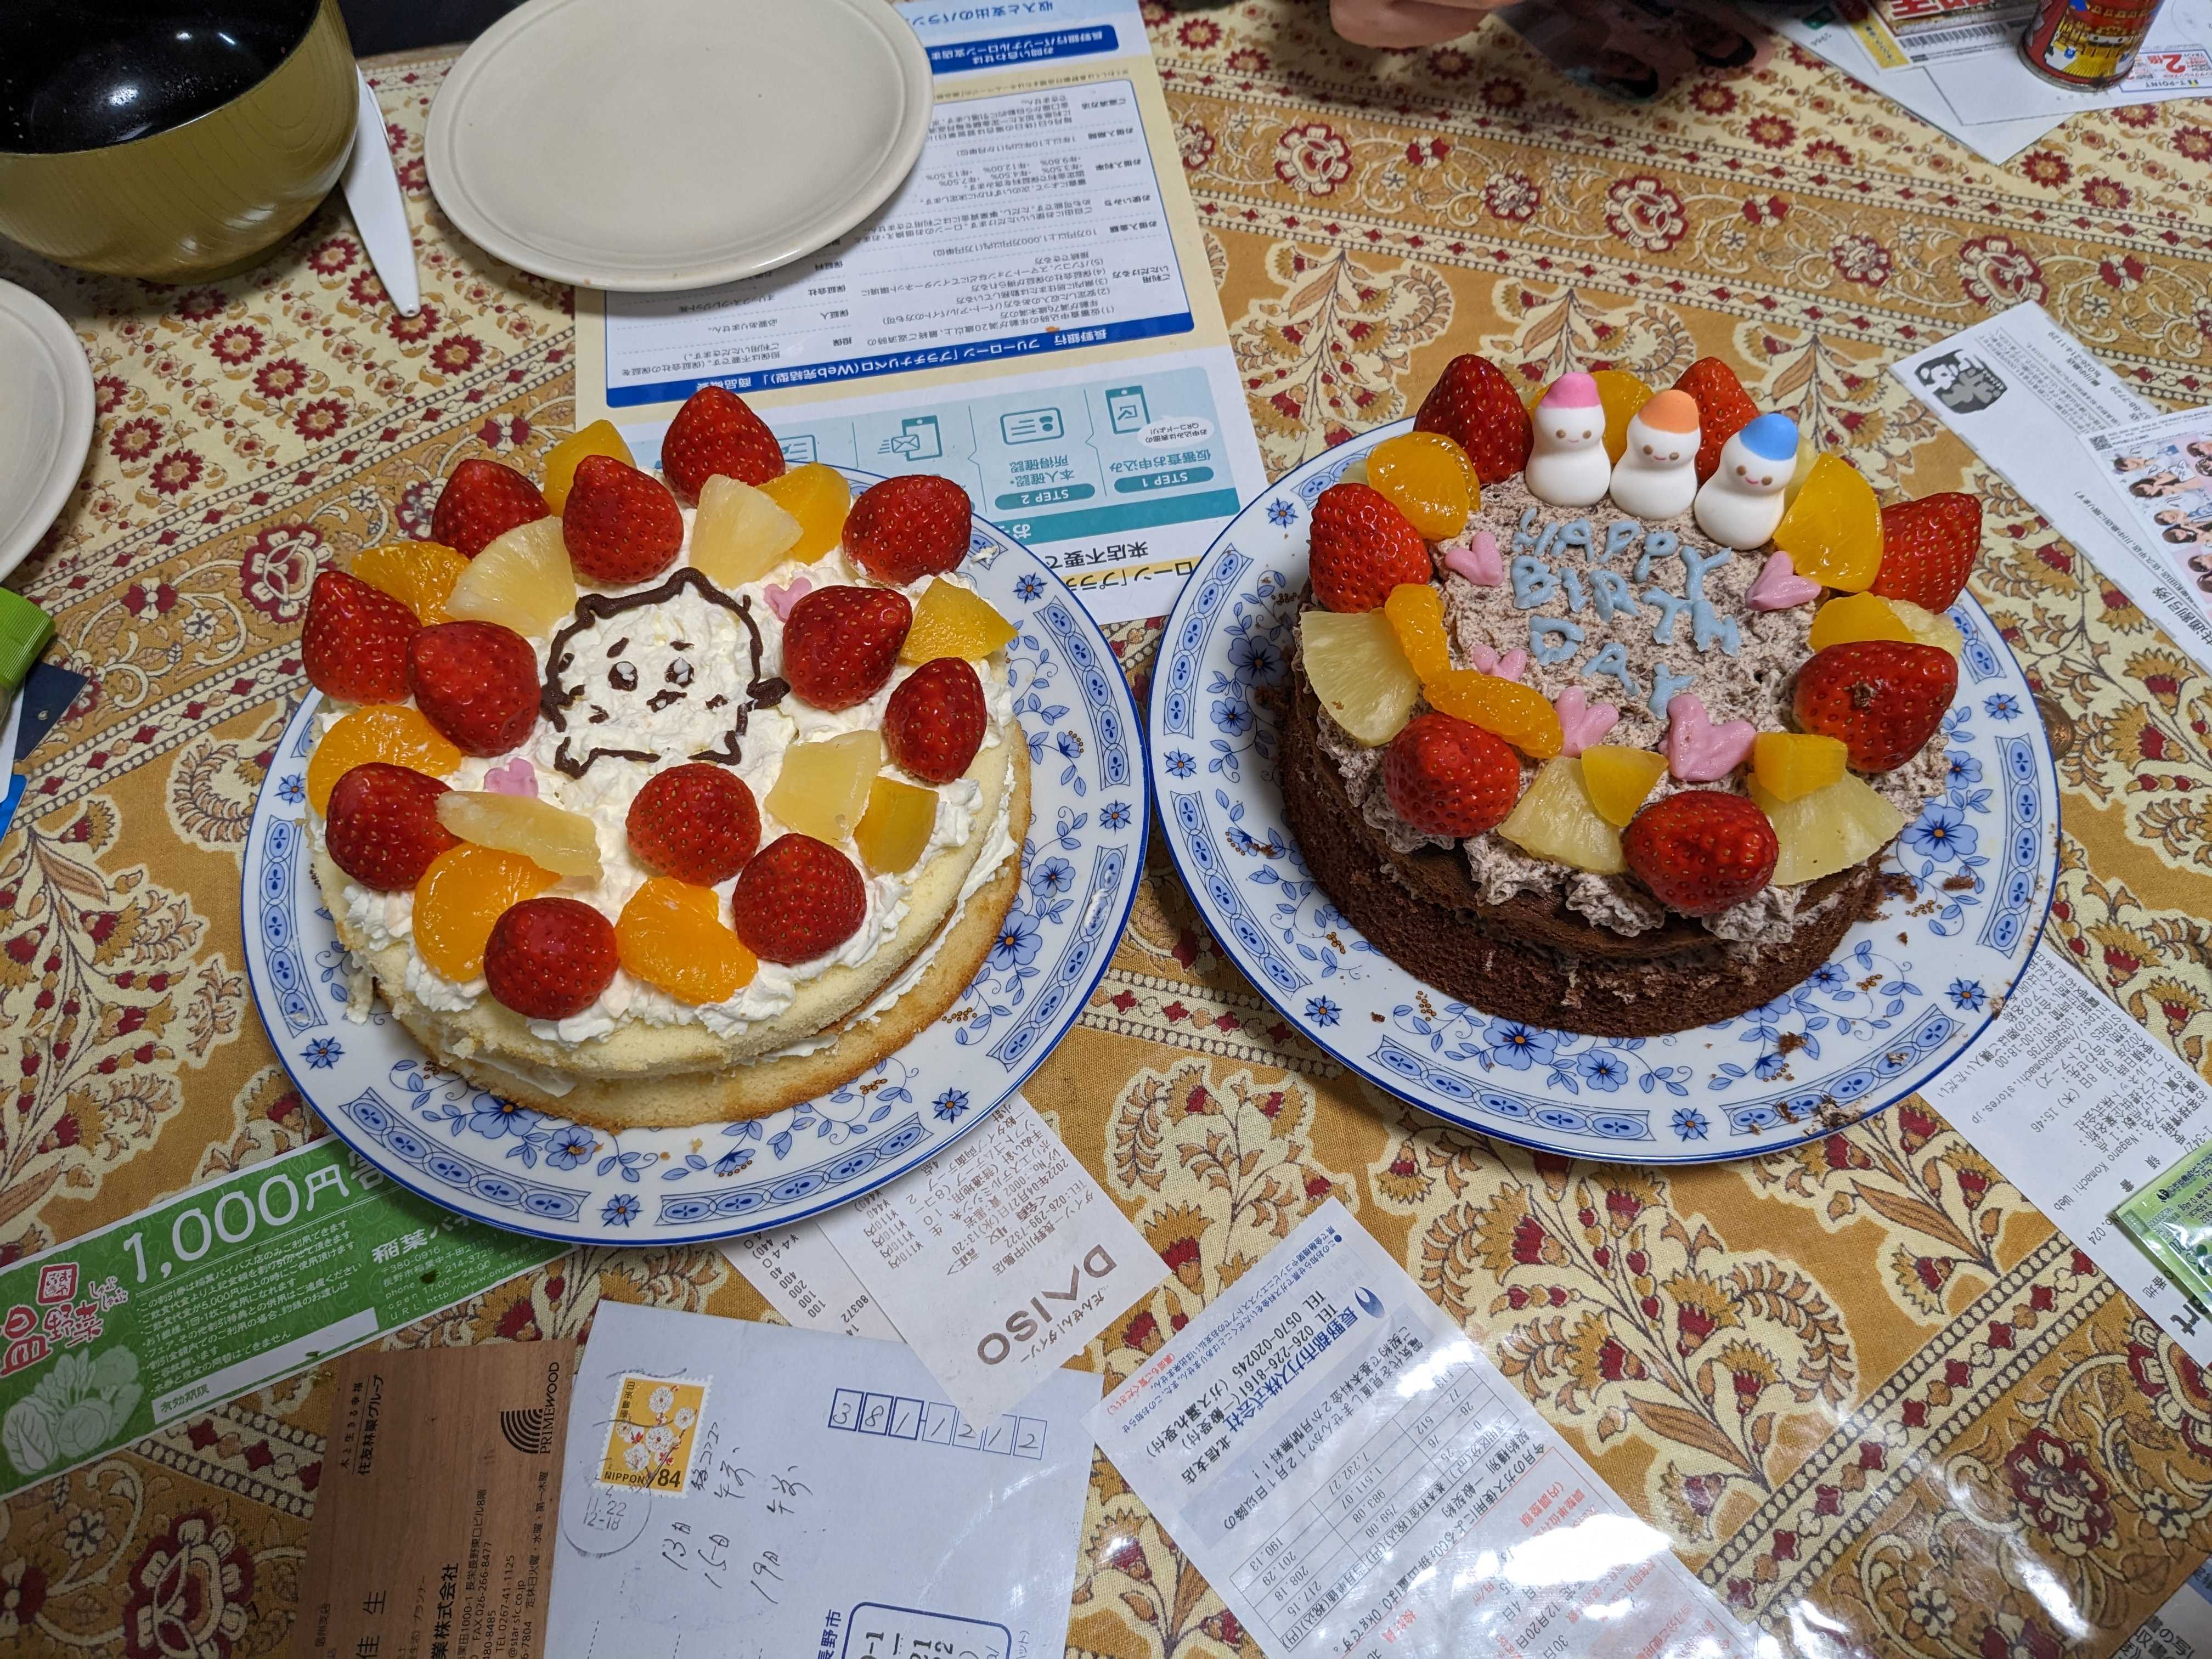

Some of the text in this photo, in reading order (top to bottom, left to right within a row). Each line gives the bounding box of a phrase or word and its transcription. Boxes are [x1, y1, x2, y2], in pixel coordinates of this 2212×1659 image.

[928, 30, 1103, 61] 長野銀行パーソナルローン支店ま
[1111, 264, 1168, 279] いただける方
[1142, 272, 1170, 284] ご利用
[808, 284, 845, 296] 保証会社
[820, 308, 849, 320] 保証人
[832, 336, 852, 346] 担保
[1053, 328, 1107, 347] 長野銀行
[1009, 454, 1068, 473] 所得確認
[1108, 448, 1211, 473] 仮審査お申込み
[1141, 471, 1188, 487] STEP 1
[1020, 489, 1069, 504] STEP 2
[1529, 616, 1695, 720] DAY
[2001, 966, 2067, 1026] たストアの名称
[1969, 1002, 2111, 1126] https://naganokomachi.stores.jp
[2072, 1049, 2165, 1133] ウェルネット株式会社
[989, 1101, 1014, 1124] 小計
[920, 1158, 941, 1177] 4点
[948, 1137, 1052, 1223] ポリエステルミシン糸
[2072, 1160, 2109, 1196] Komachi
[2052, 1193, 2073, 1214] Web
[990, 1187, 1096, 1277] ダイソー長野川中島店
[769, 1265, 783, 1280] 40
[777, 1269, 798, 1290] 400
[384, 1279, 416, 1300] phone
[787, 1278, 808, 1300] 200
[797, 1288, 817, 1310] 100
[1301, 1289, 1326, 1313] TEL
[806, 1297, 827, 1319] 100
[839, 1294, 870, 1324] 80372
[971, 1242, 1118, 1371] DAISO
[1313, 1302, 1338, 1326] TEL
[1229, 1310, 1303, 1379] 0570-020245
[159, 1383, 210, 1413] 有効期限
[539, 1361, 560, 1454] PRIMEWOOD
[1179, 1304, 1359, 1486] 長野都市ガス株式会社 北信支店
[357, 1374, 386, 1476] 住友林業グループ
[1414, 1414, 1434, 1436] 512
[1426, 1432, 1441, 1449] 76
[1484, 1428, 1531, 1475] 契約種別
[603, 1468, 682, 1488] NIPPON 84
[1350, 1488, 1387, 1524] 983.08
[1439, 1472, 1486, 1519] 一般契約
[1285, 1447, 1454, 1617] 25 759.00 217.15
[1248, 1536, 1284, 1572] 190.13
[1260, 1550, 1297, 1587] 201.29
[472, 1541, 493, 1641] FAX 026-266-8477
[1272, 1565, 1310, 1601] 208.18
[495, 1555, 516, 1653] TEL 0267-41-1125
